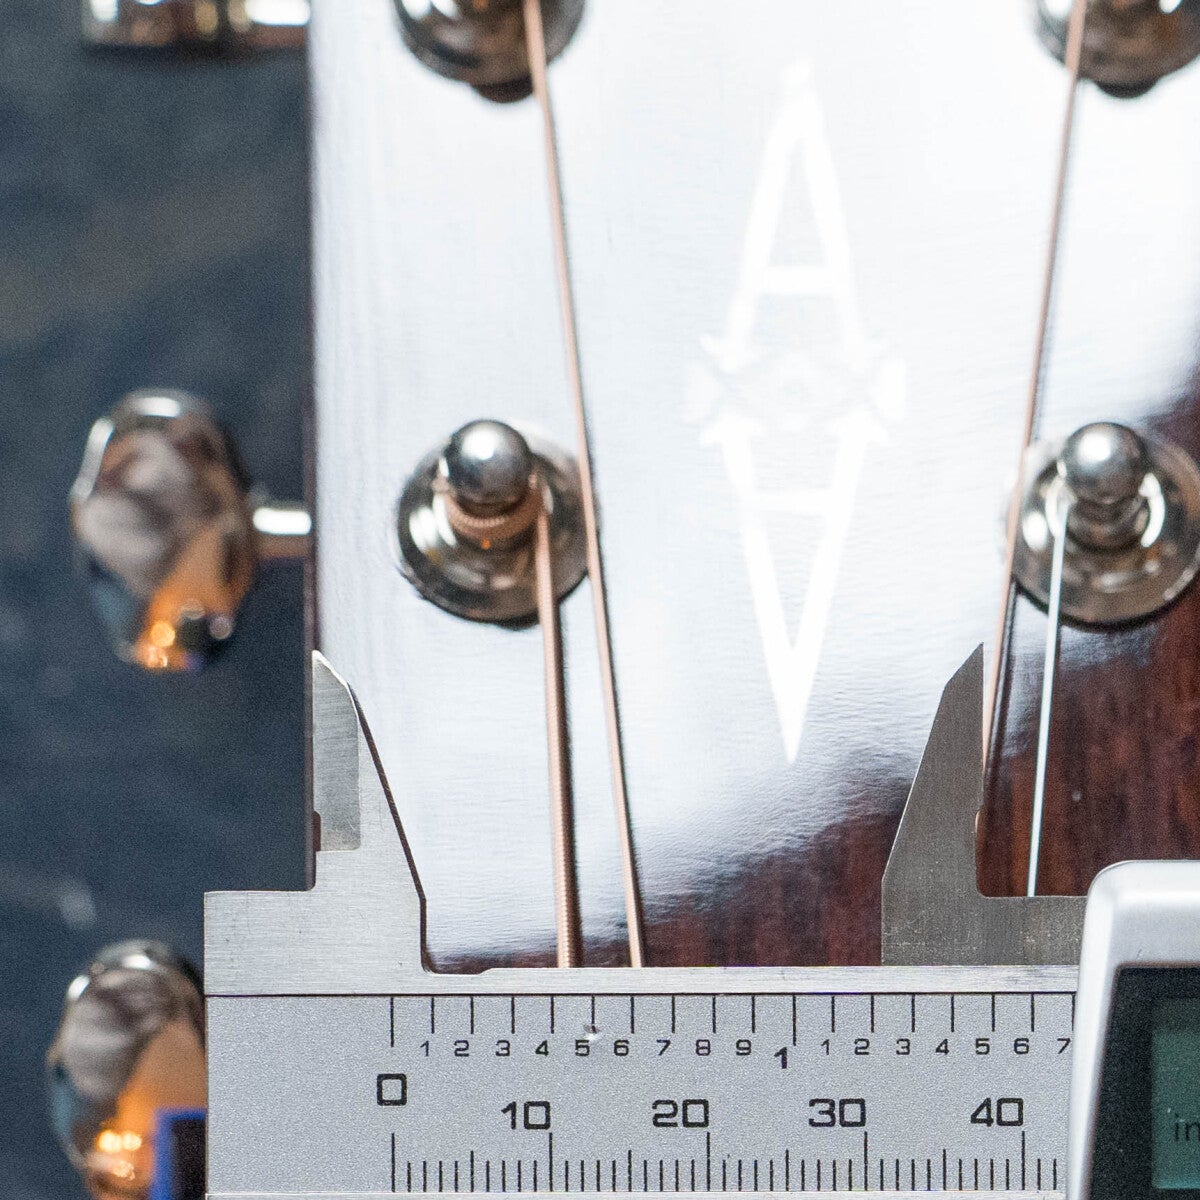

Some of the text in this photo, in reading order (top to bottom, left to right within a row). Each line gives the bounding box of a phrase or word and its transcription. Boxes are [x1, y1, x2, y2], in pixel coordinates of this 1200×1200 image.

[420, 1038, 1071, 1069] 1 2 3 4 5 6 7 8 9 1 1 2 3 4 5 6 7
[376, 1073, 407, 1106] 0
[500, 1097, 1024, 1130] 10 20 30 40
